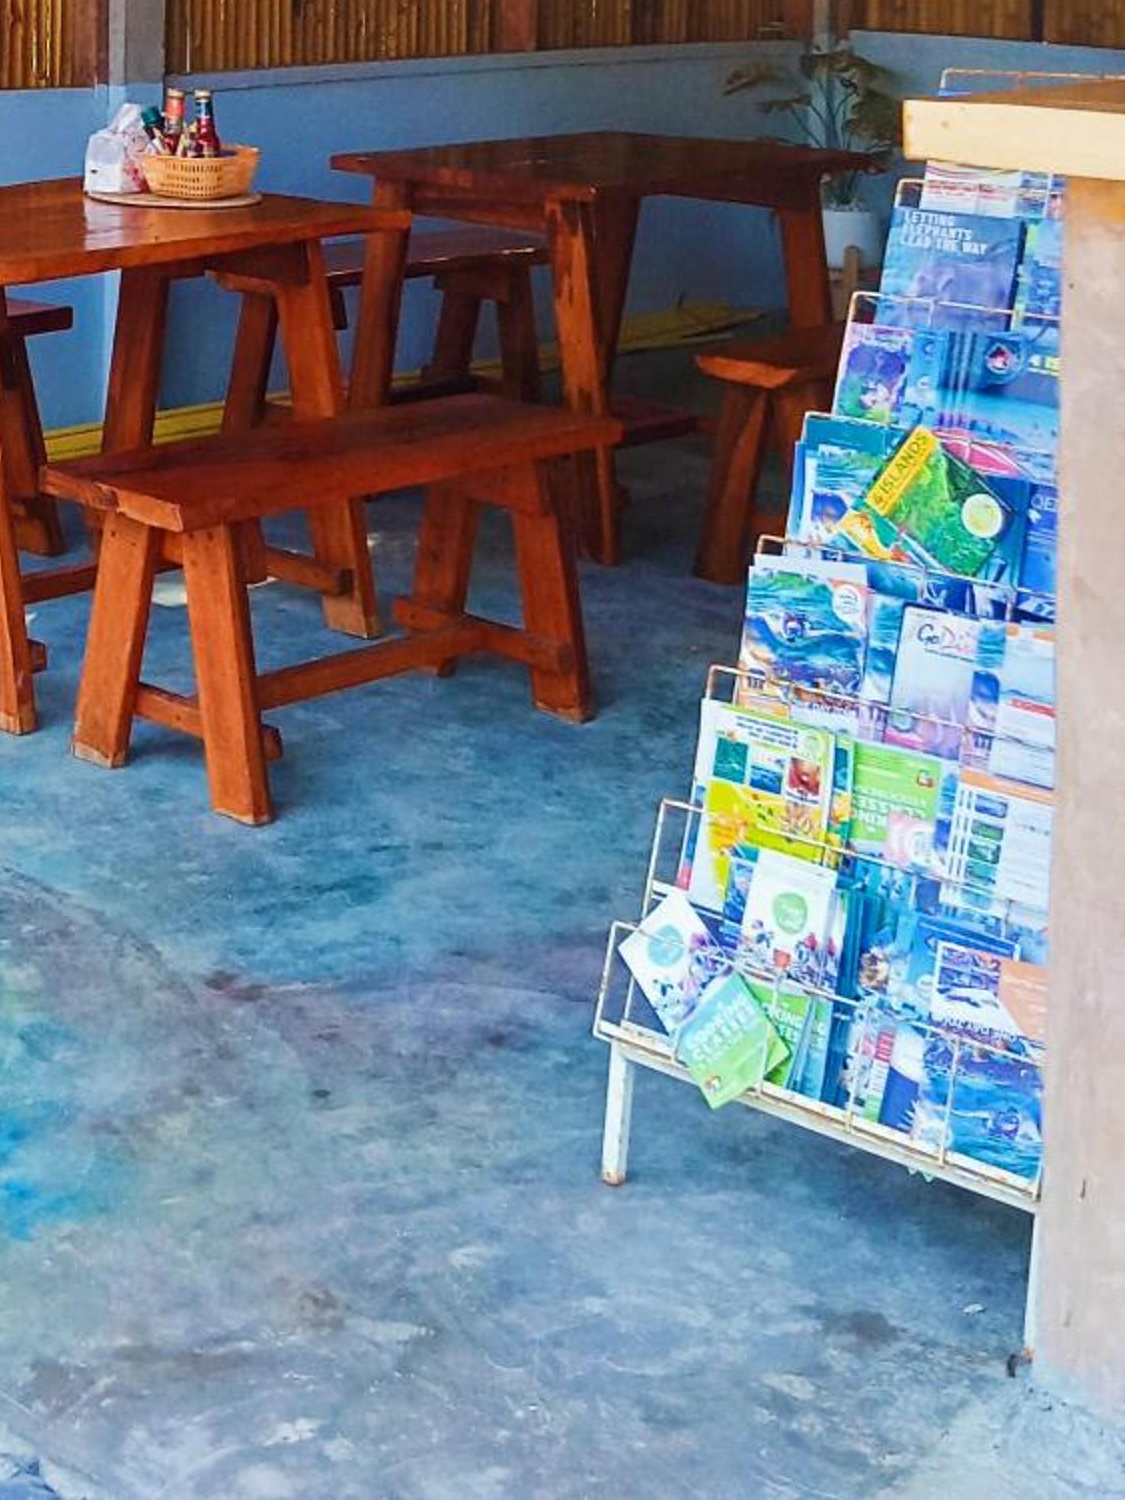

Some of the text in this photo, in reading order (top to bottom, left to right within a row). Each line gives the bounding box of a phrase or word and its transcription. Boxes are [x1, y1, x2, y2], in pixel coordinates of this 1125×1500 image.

[904, 211, 956, 227] LETTING
[902, 223, 972, 241] ELEPHANTS
[962, 241, 988, 256] WAY
[879, 434, 930, 495] ISLANDS
